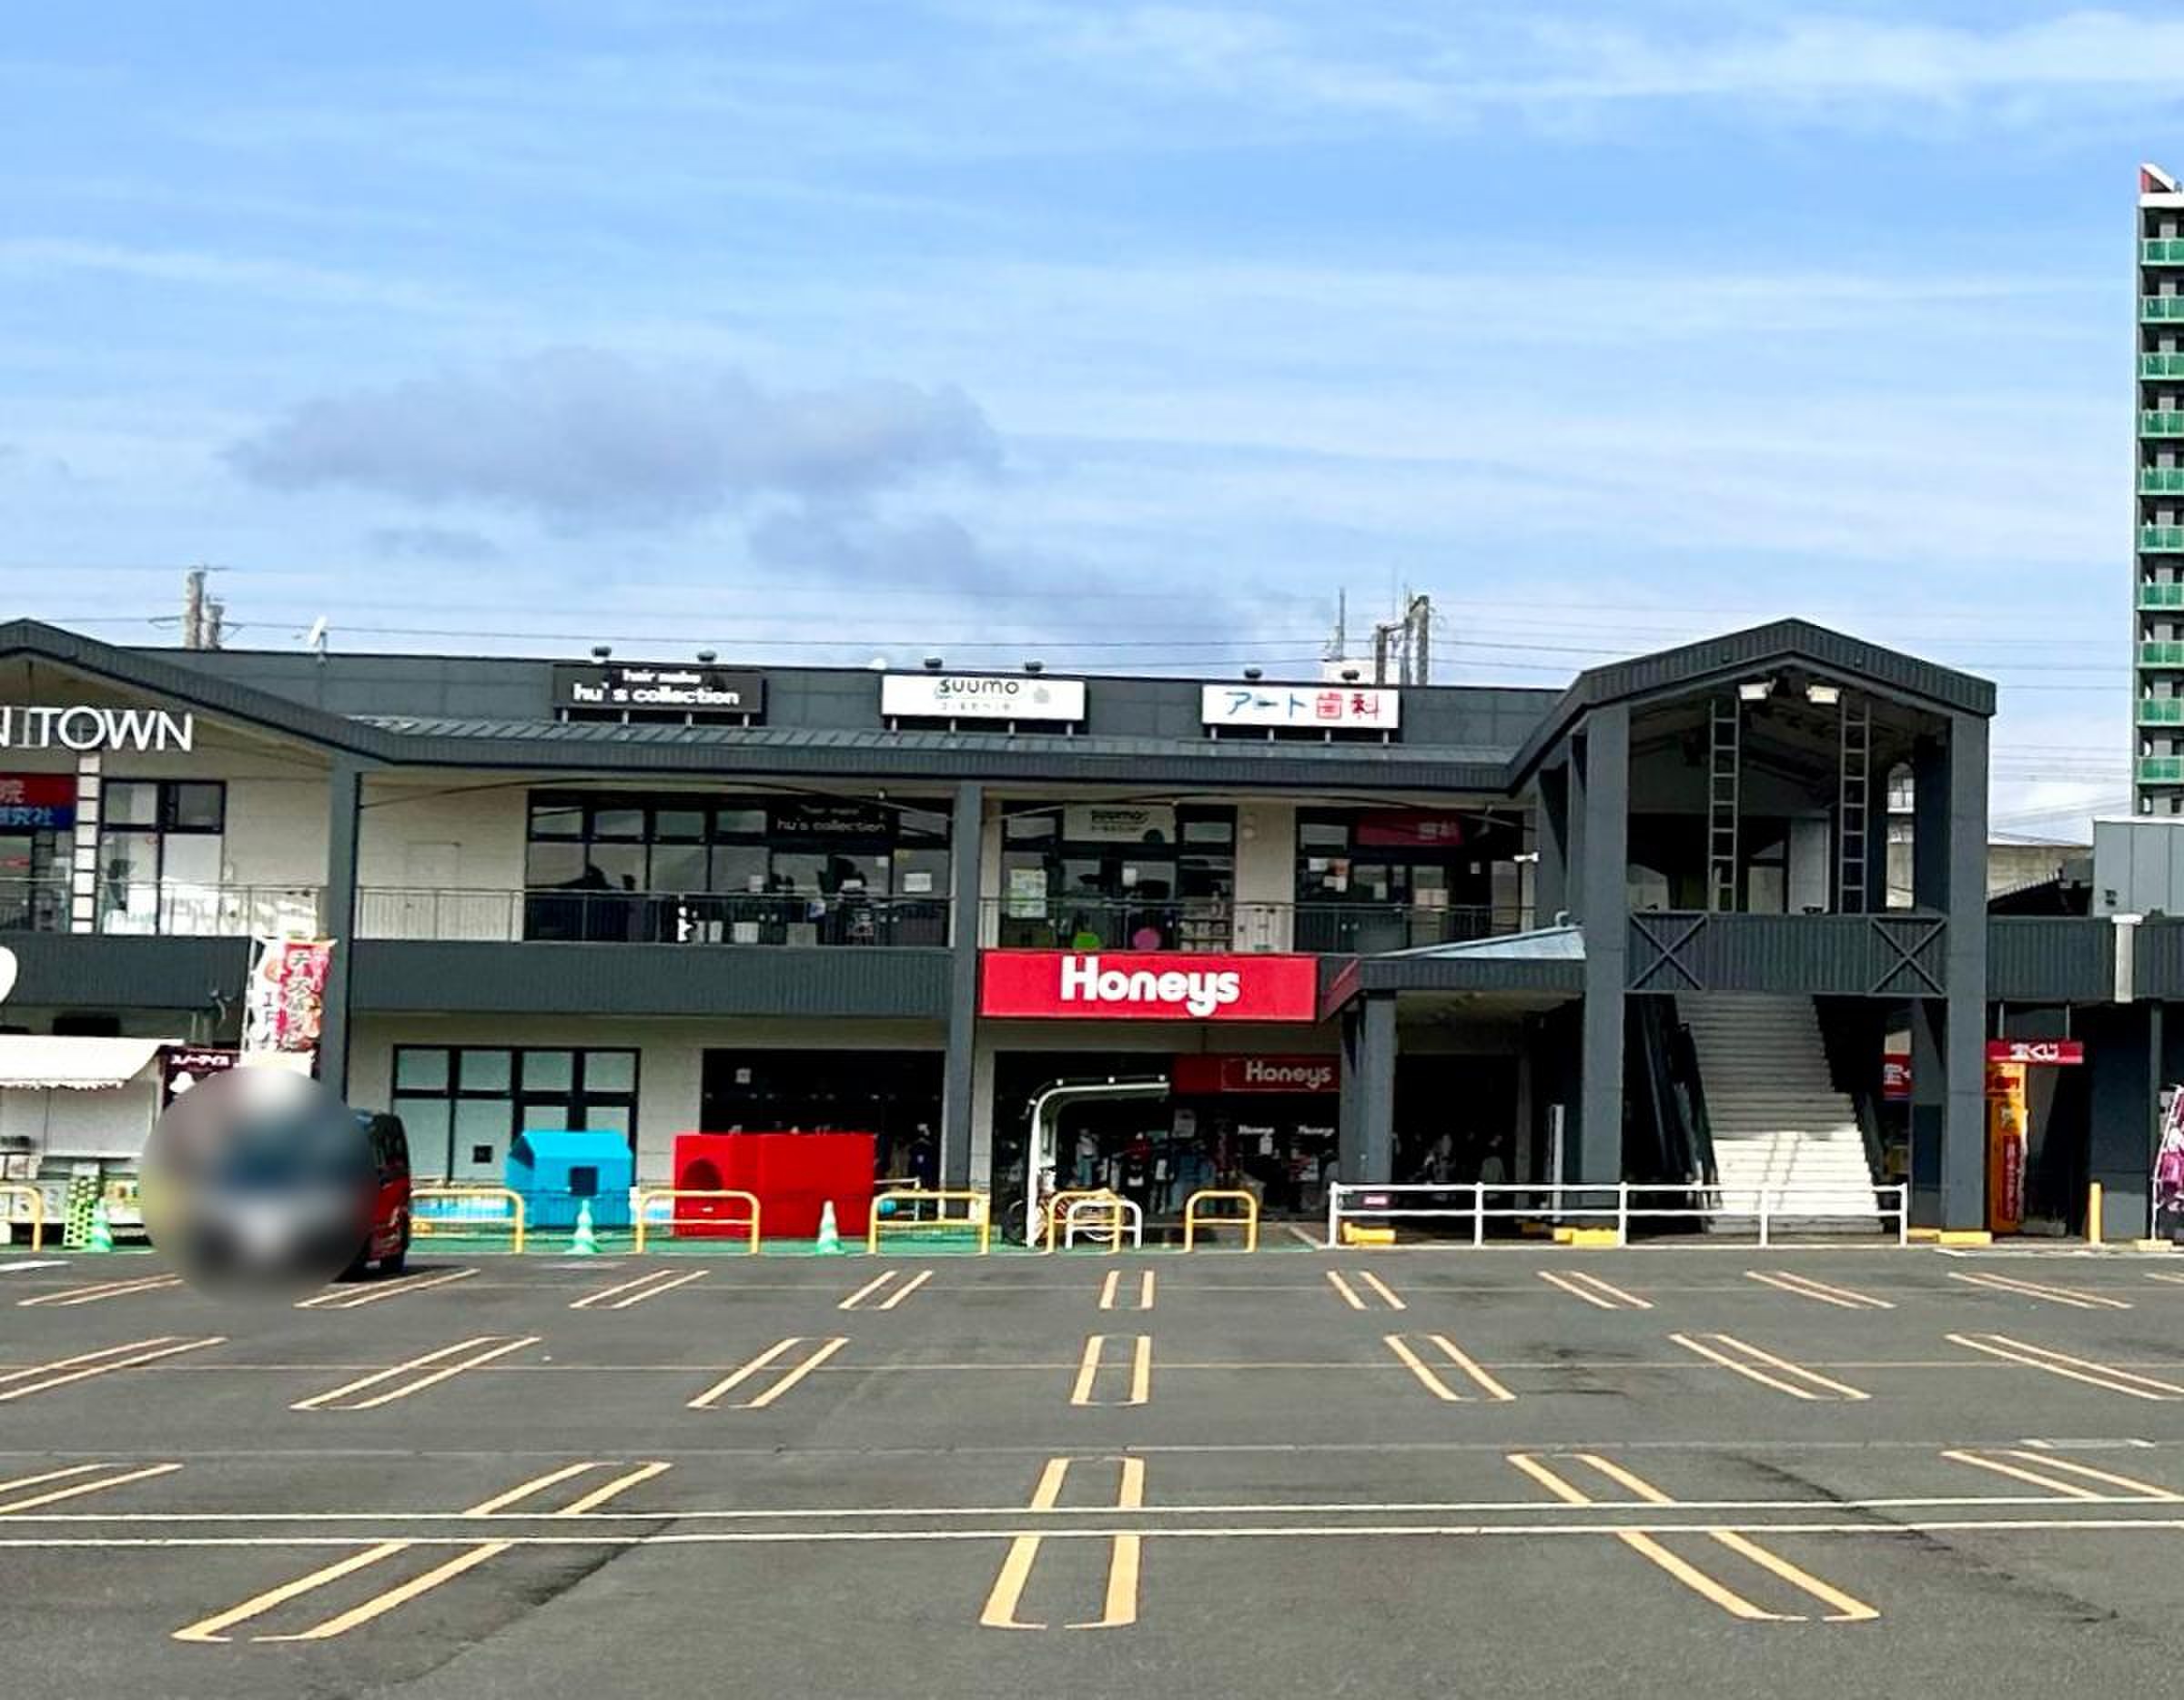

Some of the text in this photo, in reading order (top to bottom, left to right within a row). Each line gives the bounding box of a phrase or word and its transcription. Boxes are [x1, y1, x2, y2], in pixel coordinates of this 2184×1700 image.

[632, 686, 740, 704] collection
[1060, 956, 1239, 1017] Honeys
[1246, 1062, 1331, 1088] Honeys
